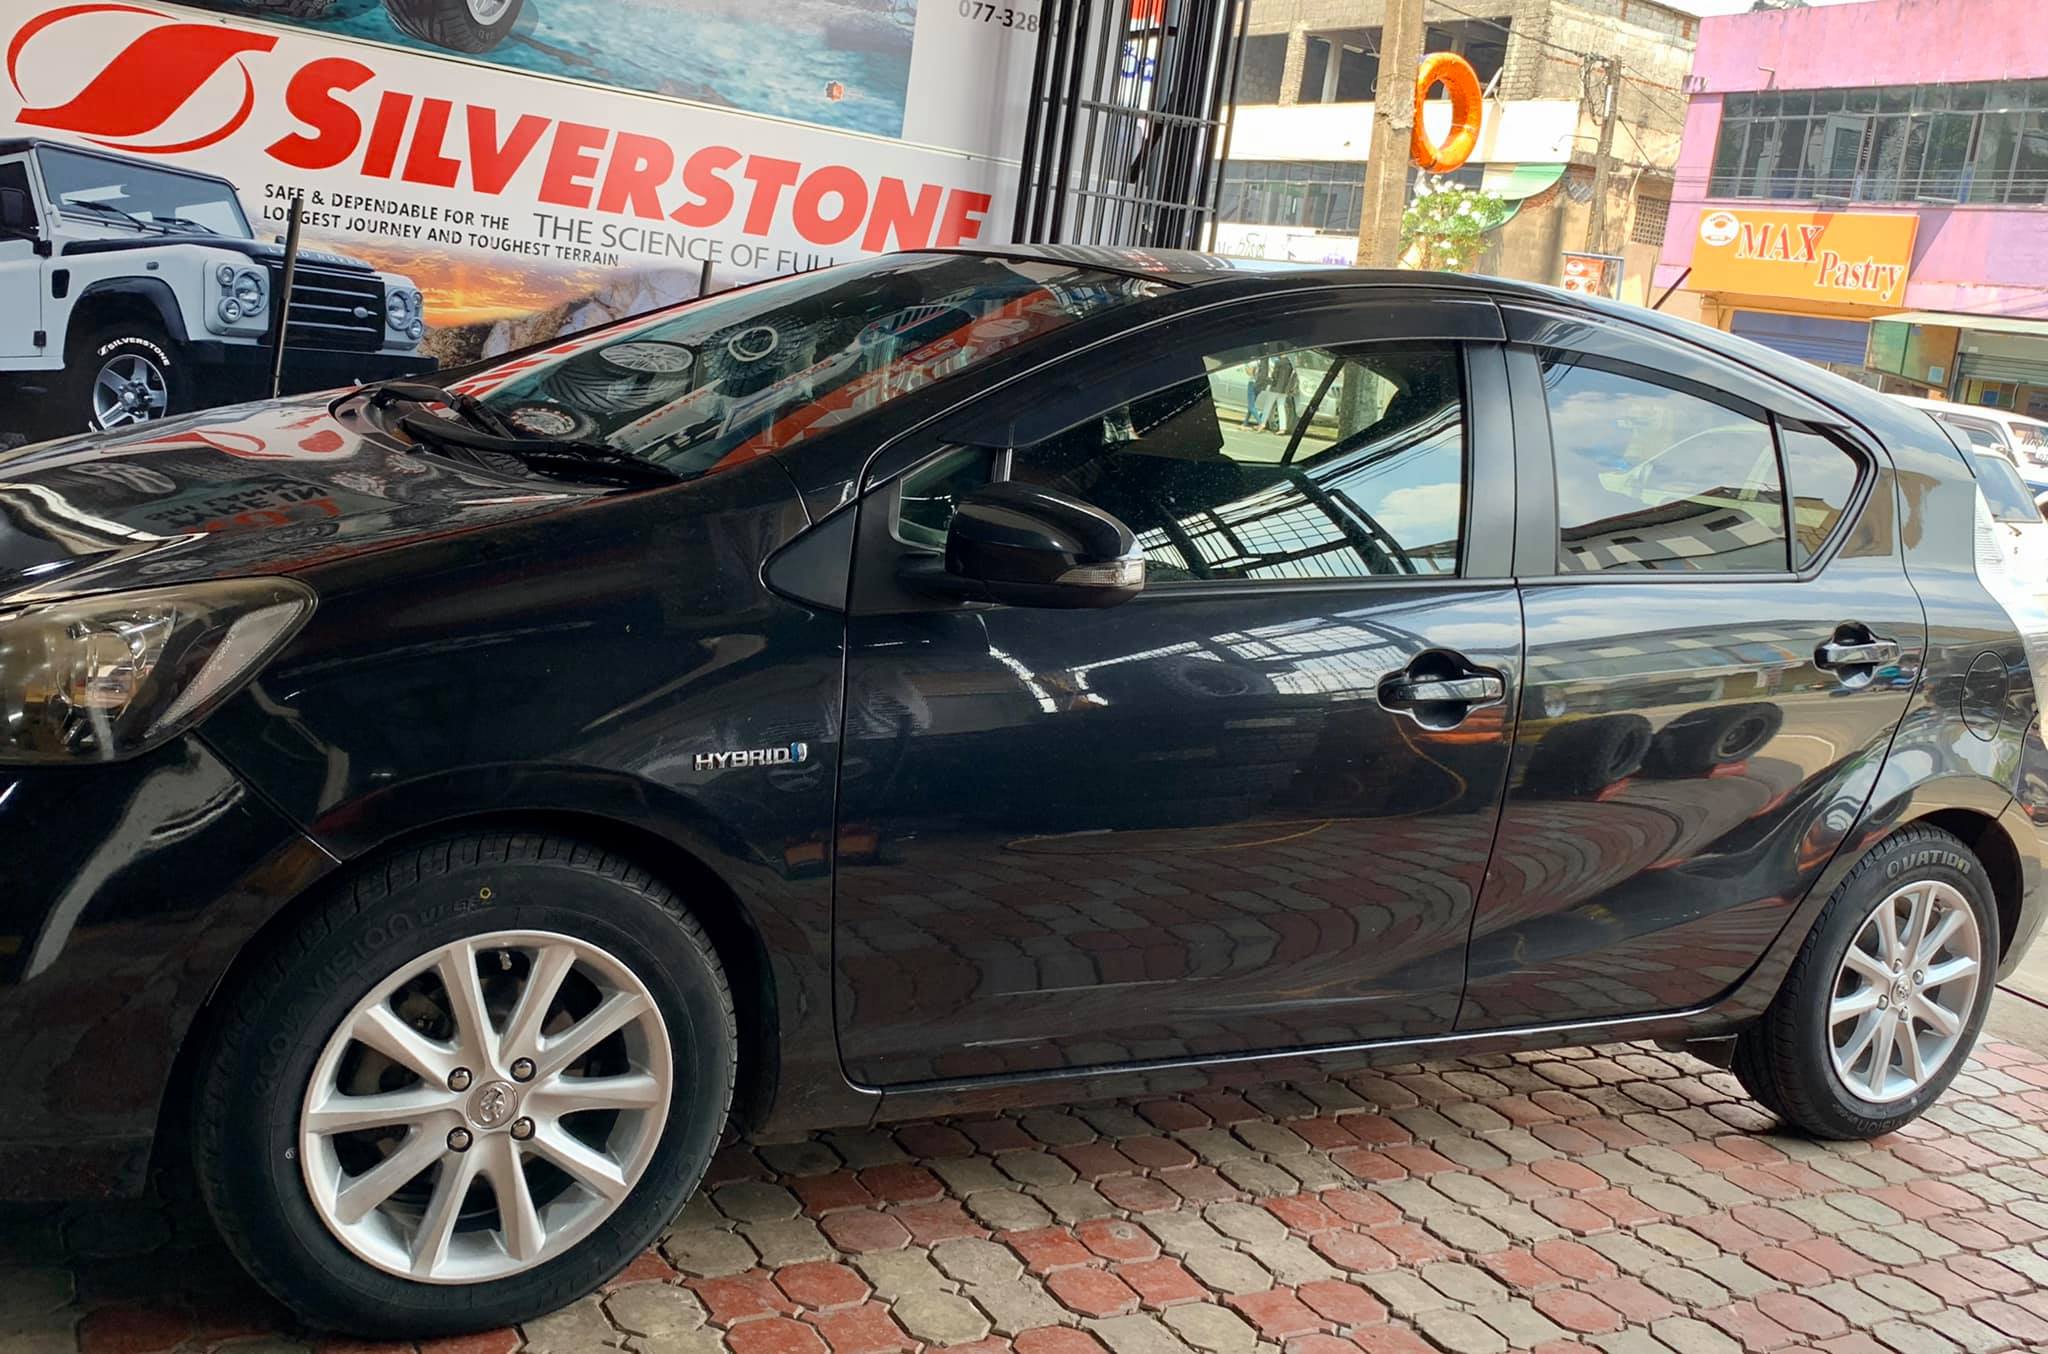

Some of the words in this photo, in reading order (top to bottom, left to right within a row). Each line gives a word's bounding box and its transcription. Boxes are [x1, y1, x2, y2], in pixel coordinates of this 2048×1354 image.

[264, 57, 992, 253] SILVERSTONE
[265, 184, 304, 201] SAFE
[312, 190, 325, 206] &
[332, 193, 438, 221] DEPENDABLE
[444, 209, 474, 226] FOR
[481, 214, 510, 231] THE
[346, 218, 422, 239] JOURNEY
[427, 228, 462, 245] AND
[468, 233, 551, 257] TOUGHEST
[556, 245, 619, 267] TERRAIN
[533, 213, 593, 245] THE
[601, 224, 723, 264] SCIENCE
[730, 244, 769, 269] OF
[1736, 223, 1823, 262] MAX
[1815, 251, 1902, 301] Pastry
[107, 337, 170, 366] SILVERSTONE
[695, 747, 792, 771] HYBRID
